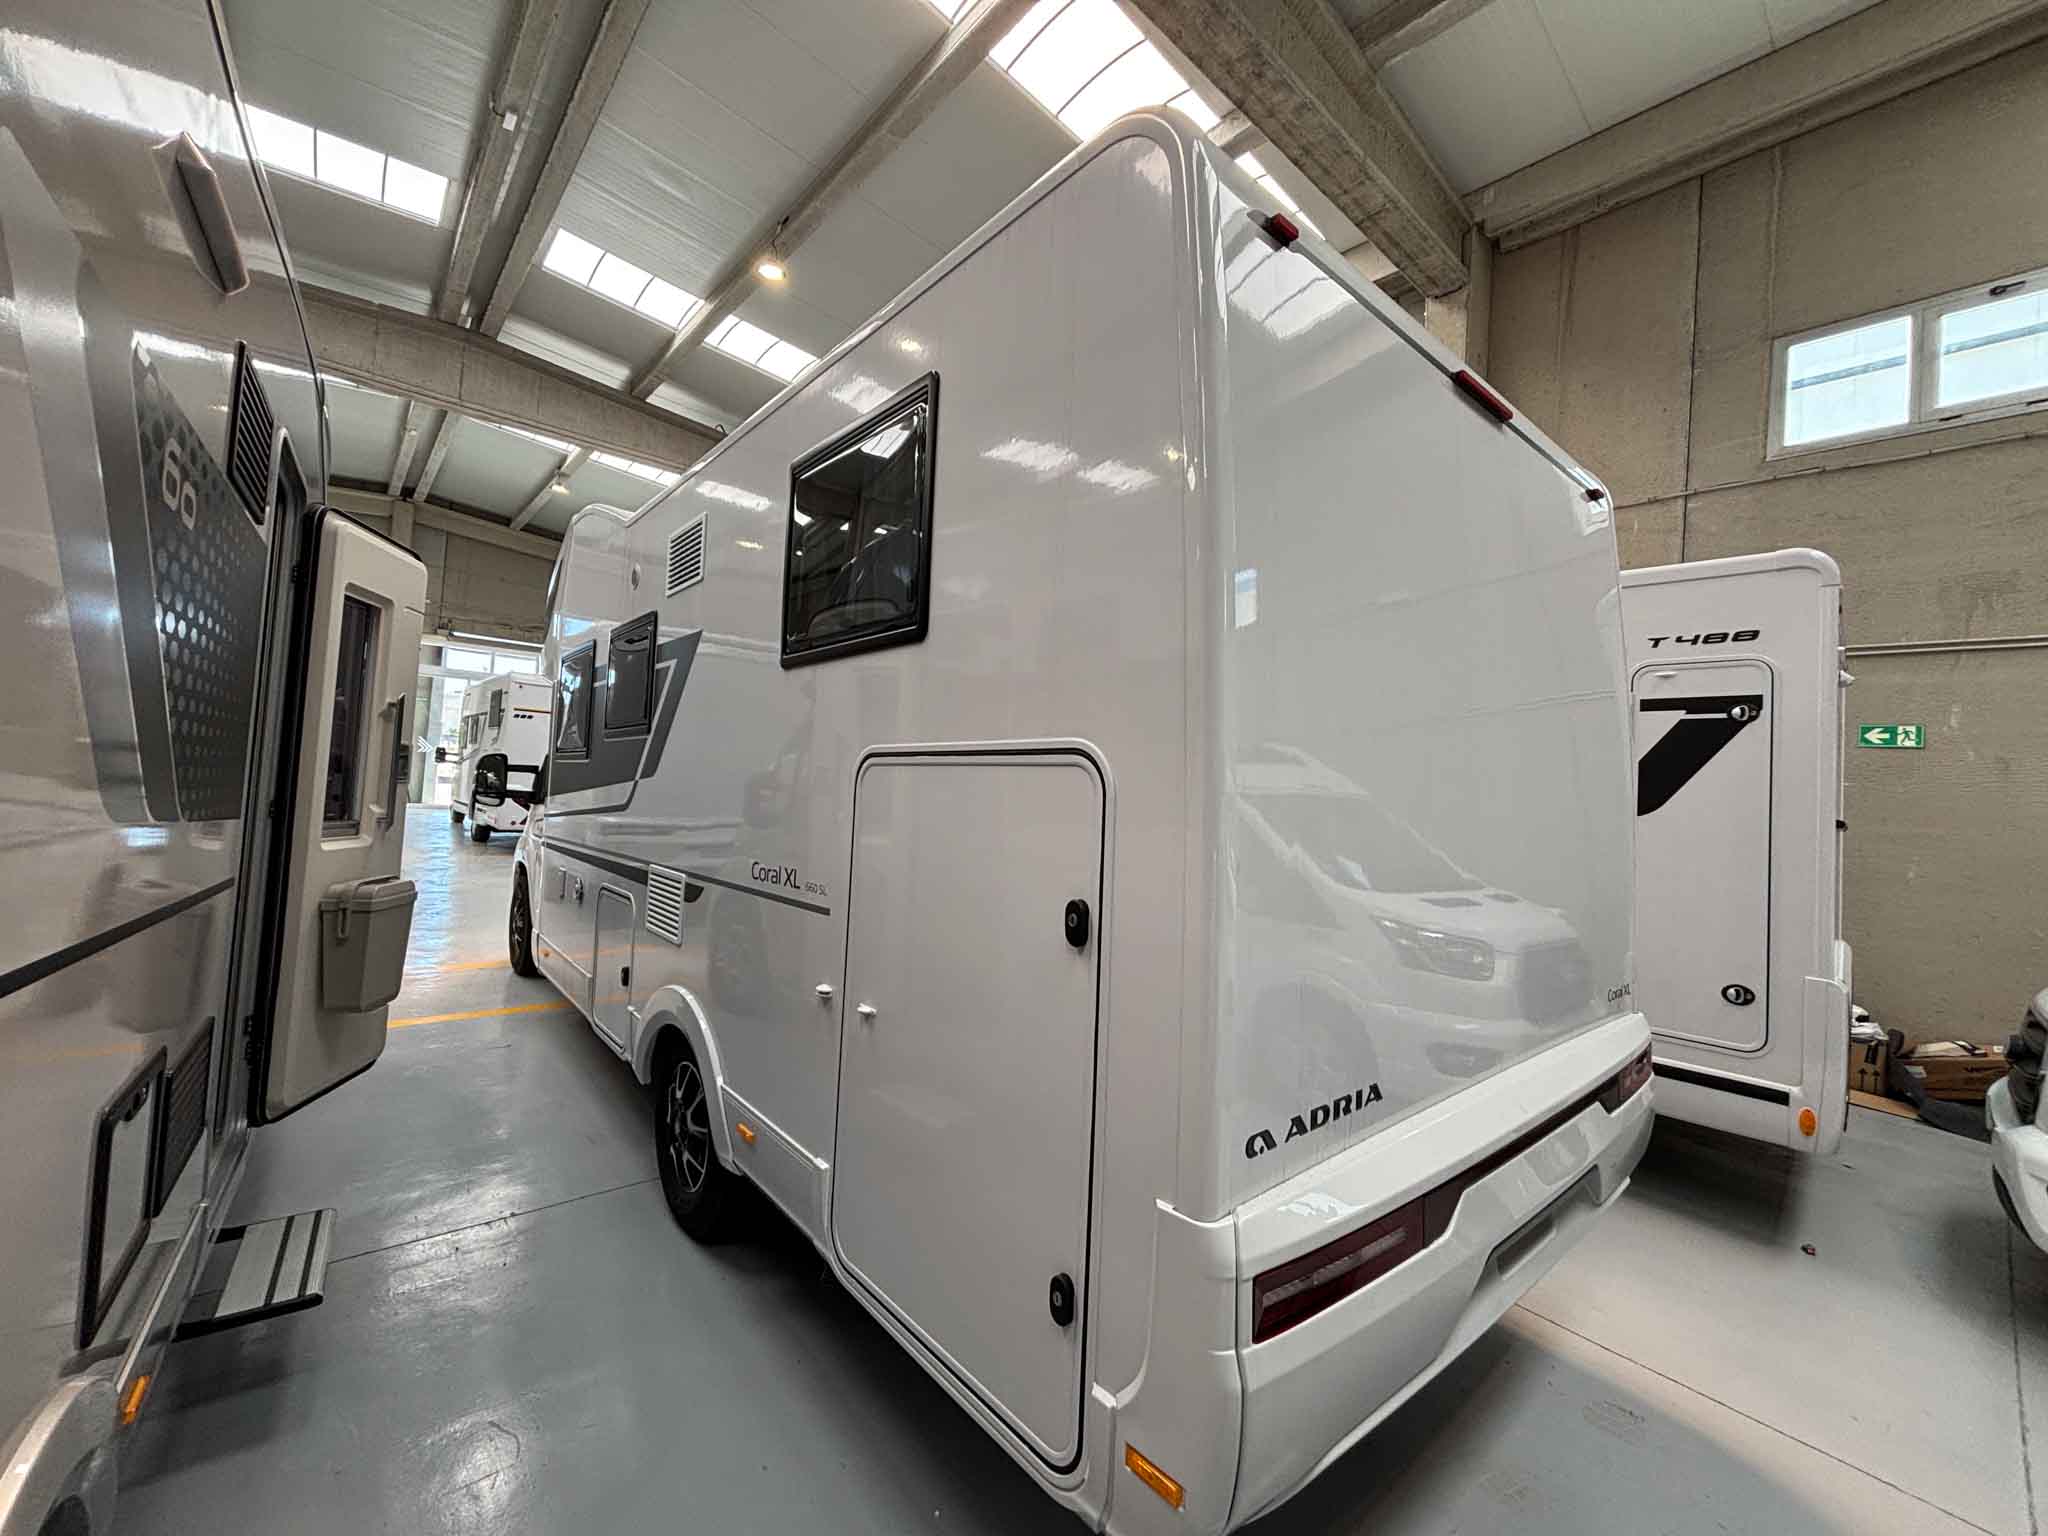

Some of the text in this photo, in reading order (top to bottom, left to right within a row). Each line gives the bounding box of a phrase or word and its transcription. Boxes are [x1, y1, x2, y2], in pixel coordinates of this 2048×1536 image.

[1647, 629, 1761, 649] T 488
[751, 861, 781, 885] Coral
[783, 867, 801, 890] XL
[1284, 1082, 1384, 1144] ADRIA
